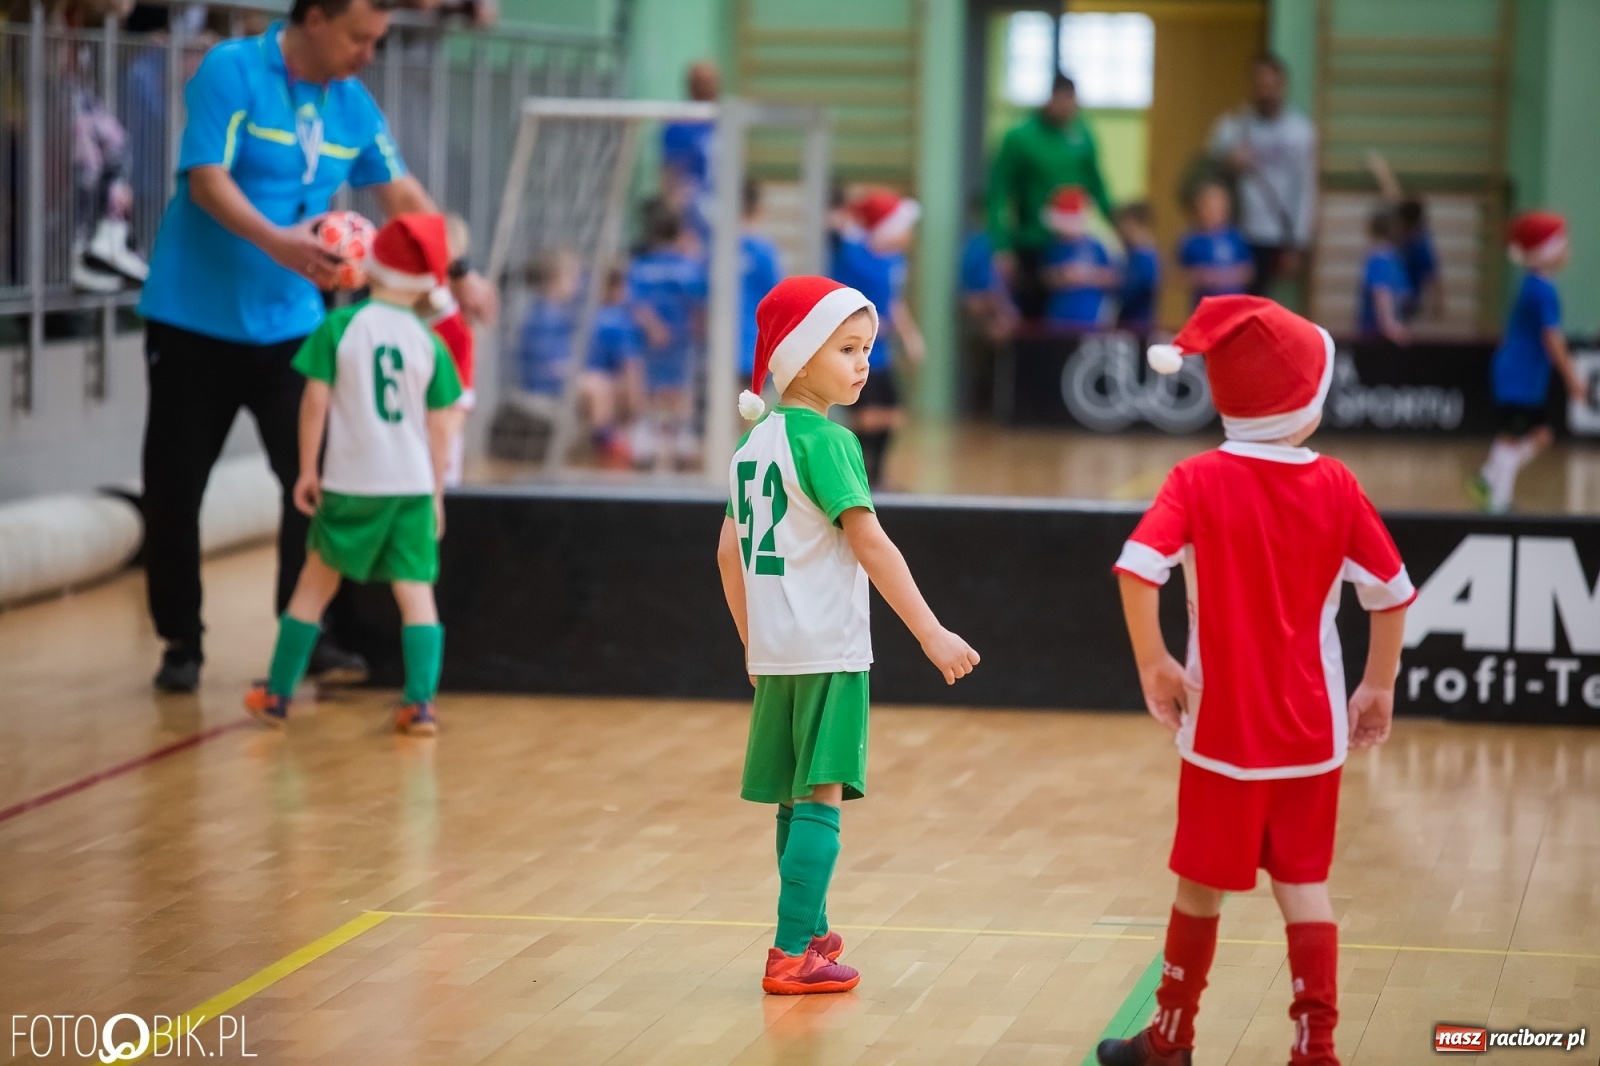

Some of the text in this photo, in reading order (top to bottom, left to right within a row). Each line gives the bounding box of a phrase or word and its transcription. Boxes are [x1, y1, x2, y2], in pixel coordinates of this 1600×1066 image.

[373, 345, 404, 424] 6
[737, 460, 788, 577] 52
[1395, 655, 1600, 709] rofi-Te
